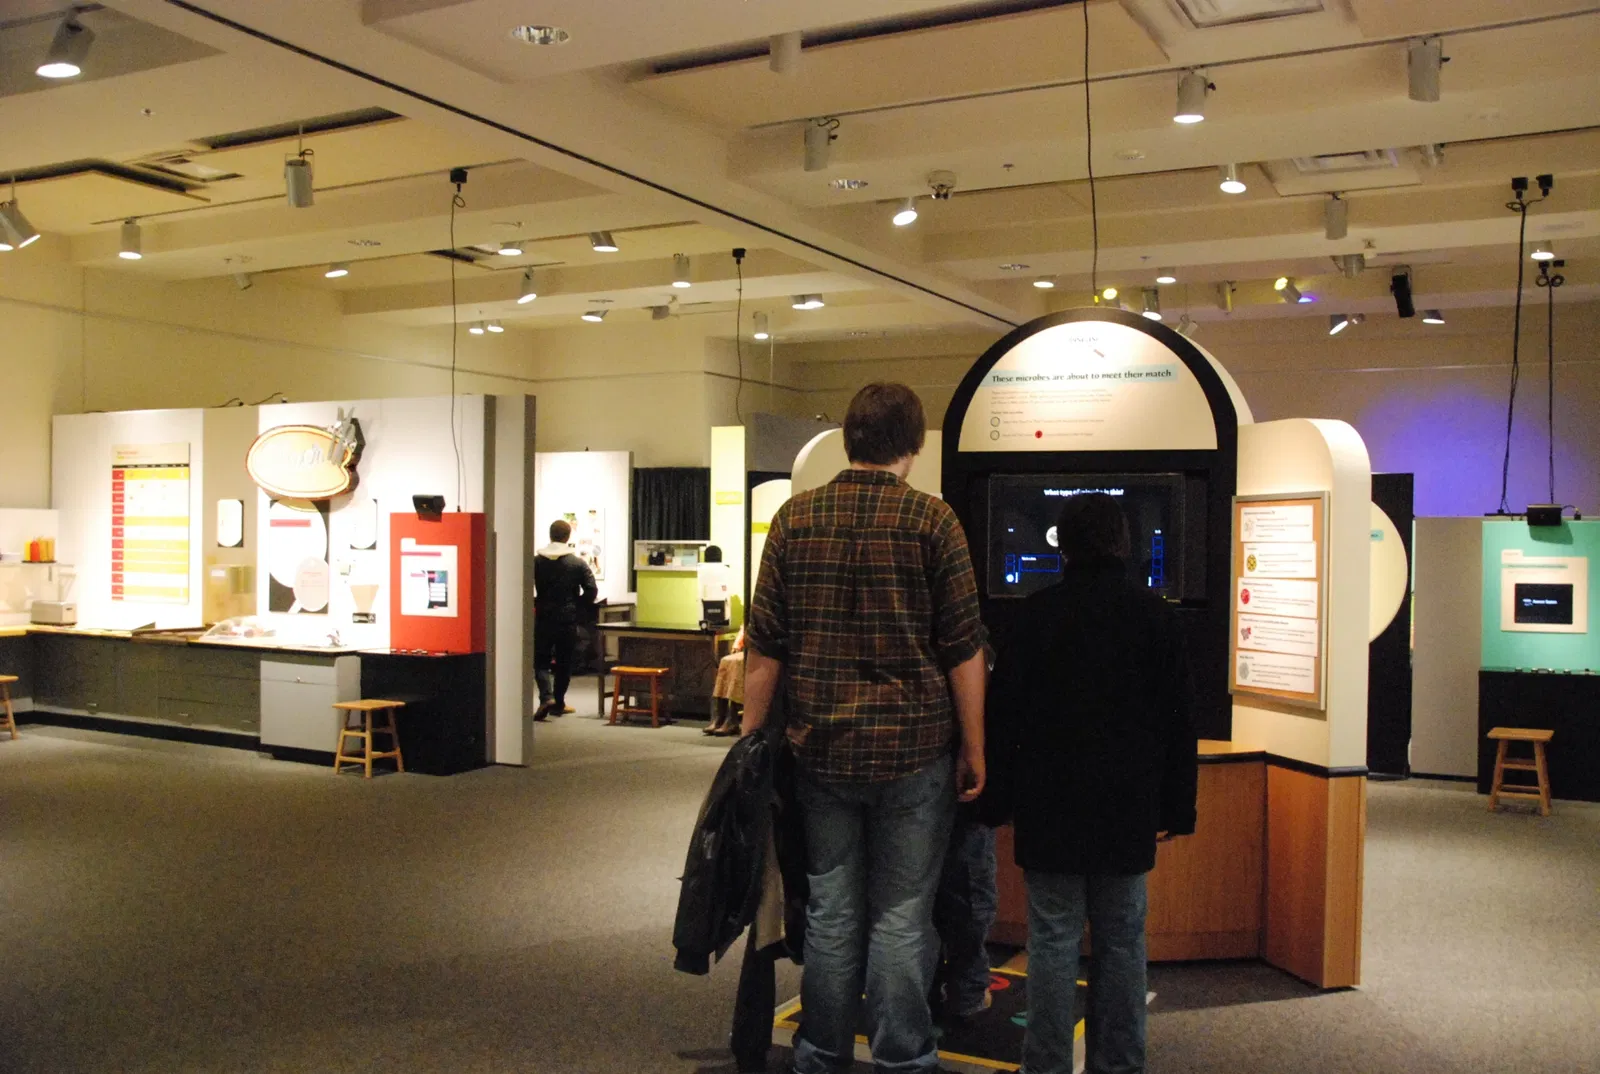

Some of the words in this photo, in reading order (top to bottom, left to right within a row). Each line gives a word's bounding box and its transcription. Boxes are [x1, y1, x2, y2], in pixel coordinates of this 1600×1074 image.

[992, 375, 1014, 383] These
[1015, 374, 1051, 382] microbes
[1066, 373, 1089, 381] about
[1124, 370, 1143, 378] their
[1145, 369, 1172, 378] match
[1059, 489, 1073, 497] type
